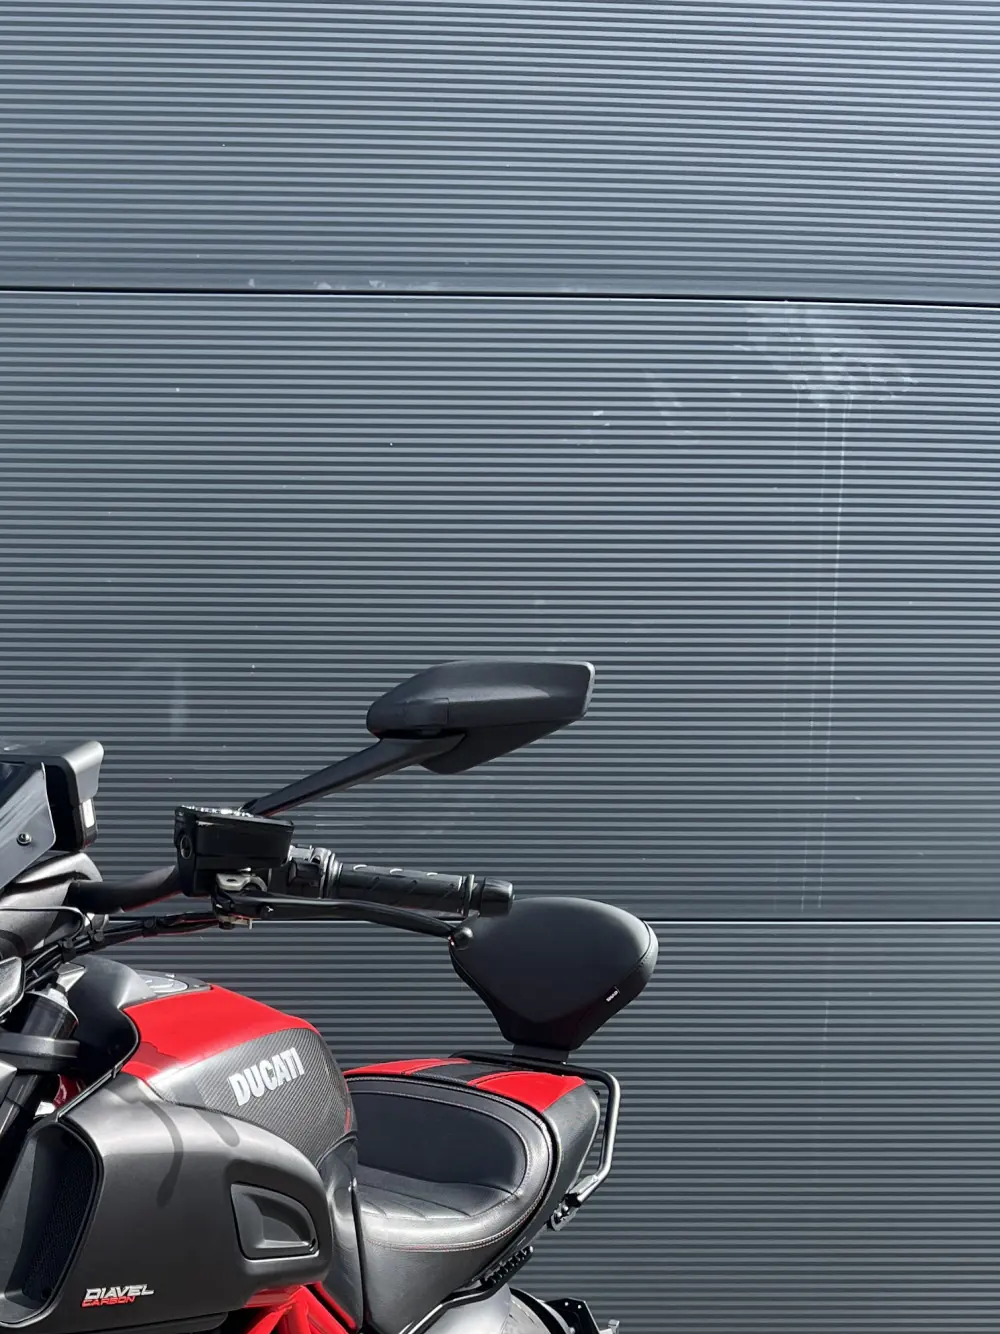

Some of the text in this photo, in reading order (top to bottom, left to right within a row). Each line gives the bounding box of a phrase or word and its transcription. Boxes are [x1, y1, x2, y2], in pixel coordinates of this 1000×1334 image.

[227, 1047, 305, 1107] DUCATI
[84, 1283, 155, 1300] DIAVEL
[81, 1295, 136, 1308] CARBON
